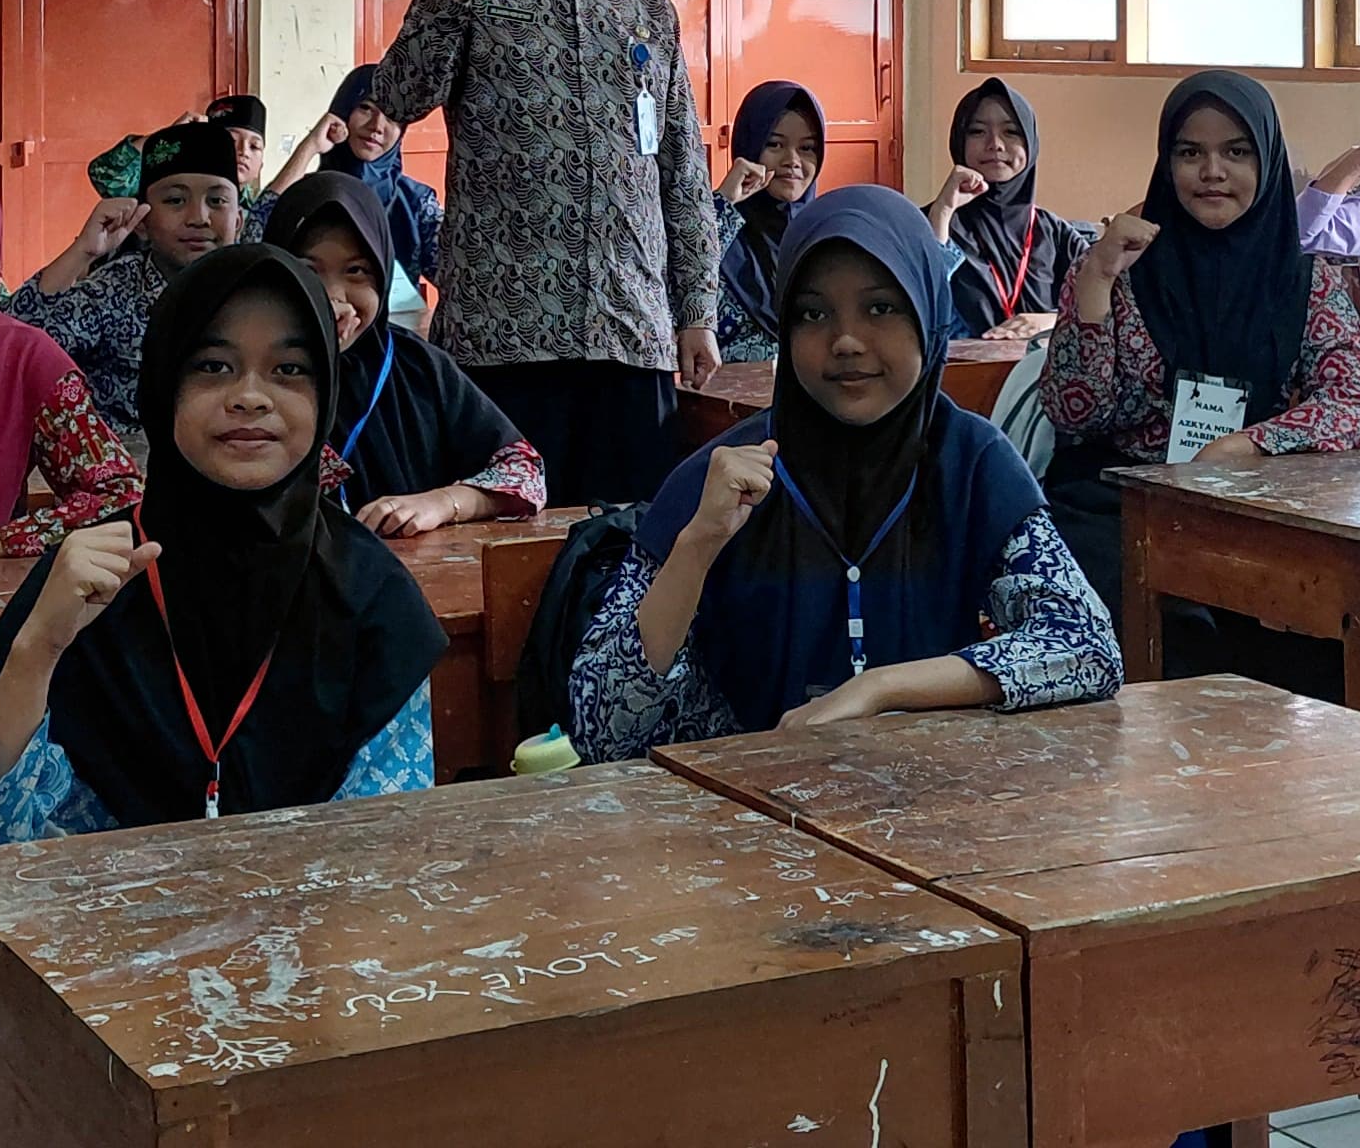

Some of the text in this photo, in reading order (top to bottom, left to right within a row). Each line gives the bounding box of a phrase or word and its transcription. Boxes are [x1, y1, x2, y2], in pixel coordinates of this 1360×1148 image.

[1195, 402, 1224, 413] NAMA
[1178, 419, 1212, 431] AZKYA
[1186, 430, 1221, 441] SABIR
[1179, 439, 1204, 449] MIFT
[481, 952, 622, 989] LOVE
